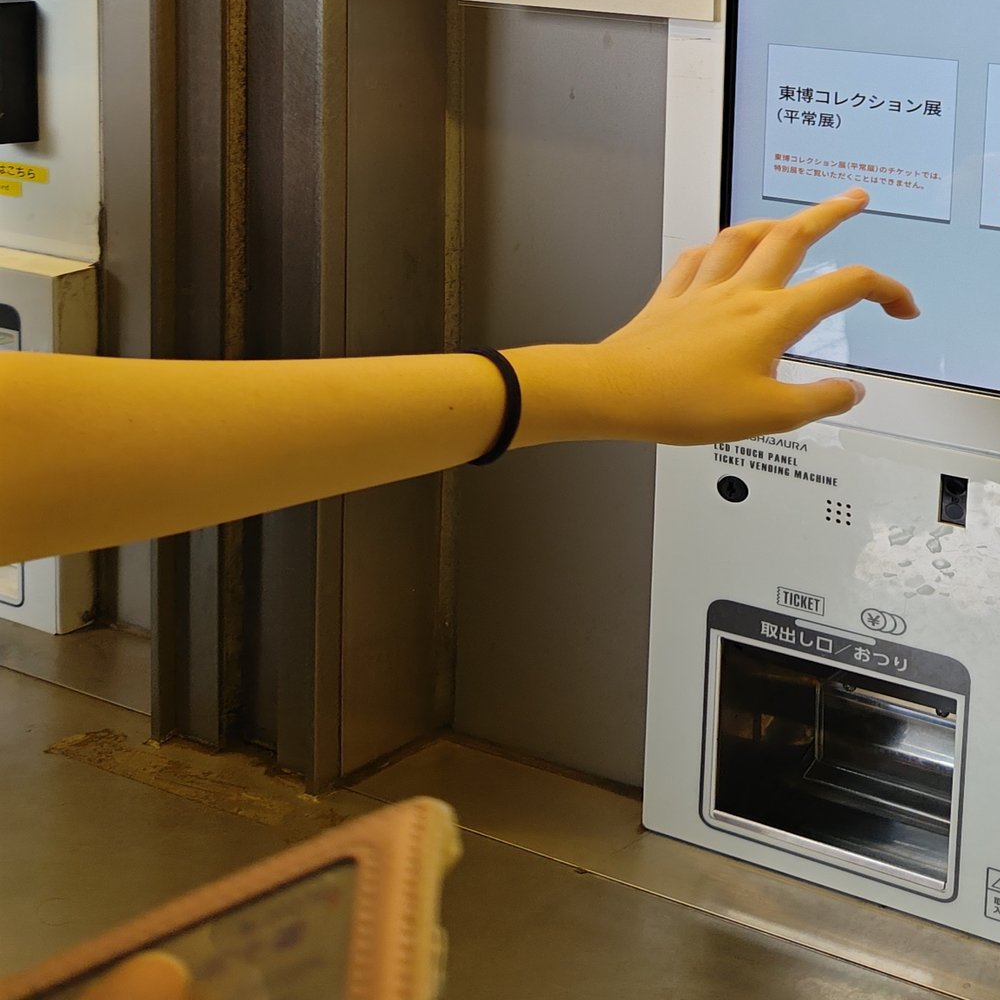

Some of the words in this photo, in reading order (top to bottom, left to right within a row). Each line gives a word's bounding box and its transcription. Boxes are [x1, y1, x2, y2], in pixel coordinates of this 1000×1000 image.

[779, 85, 942, 117] 東博コレクション展
[777, 108, 842, 129] (平常展)
[773, 164, 925, 190] 特別展をご覧いただくことはできません。
[714, 443, 730, 452] LCD
[735, 446, 764, 459] TOUCH
[768, 452, 798, 466] PANEL
[714, 453, 745, 467] TICKET
[750, 461, 790, 476] VENDING
[794, 470, 838, 487] MACHINE
[783, 590, 821, 612] TICKET
